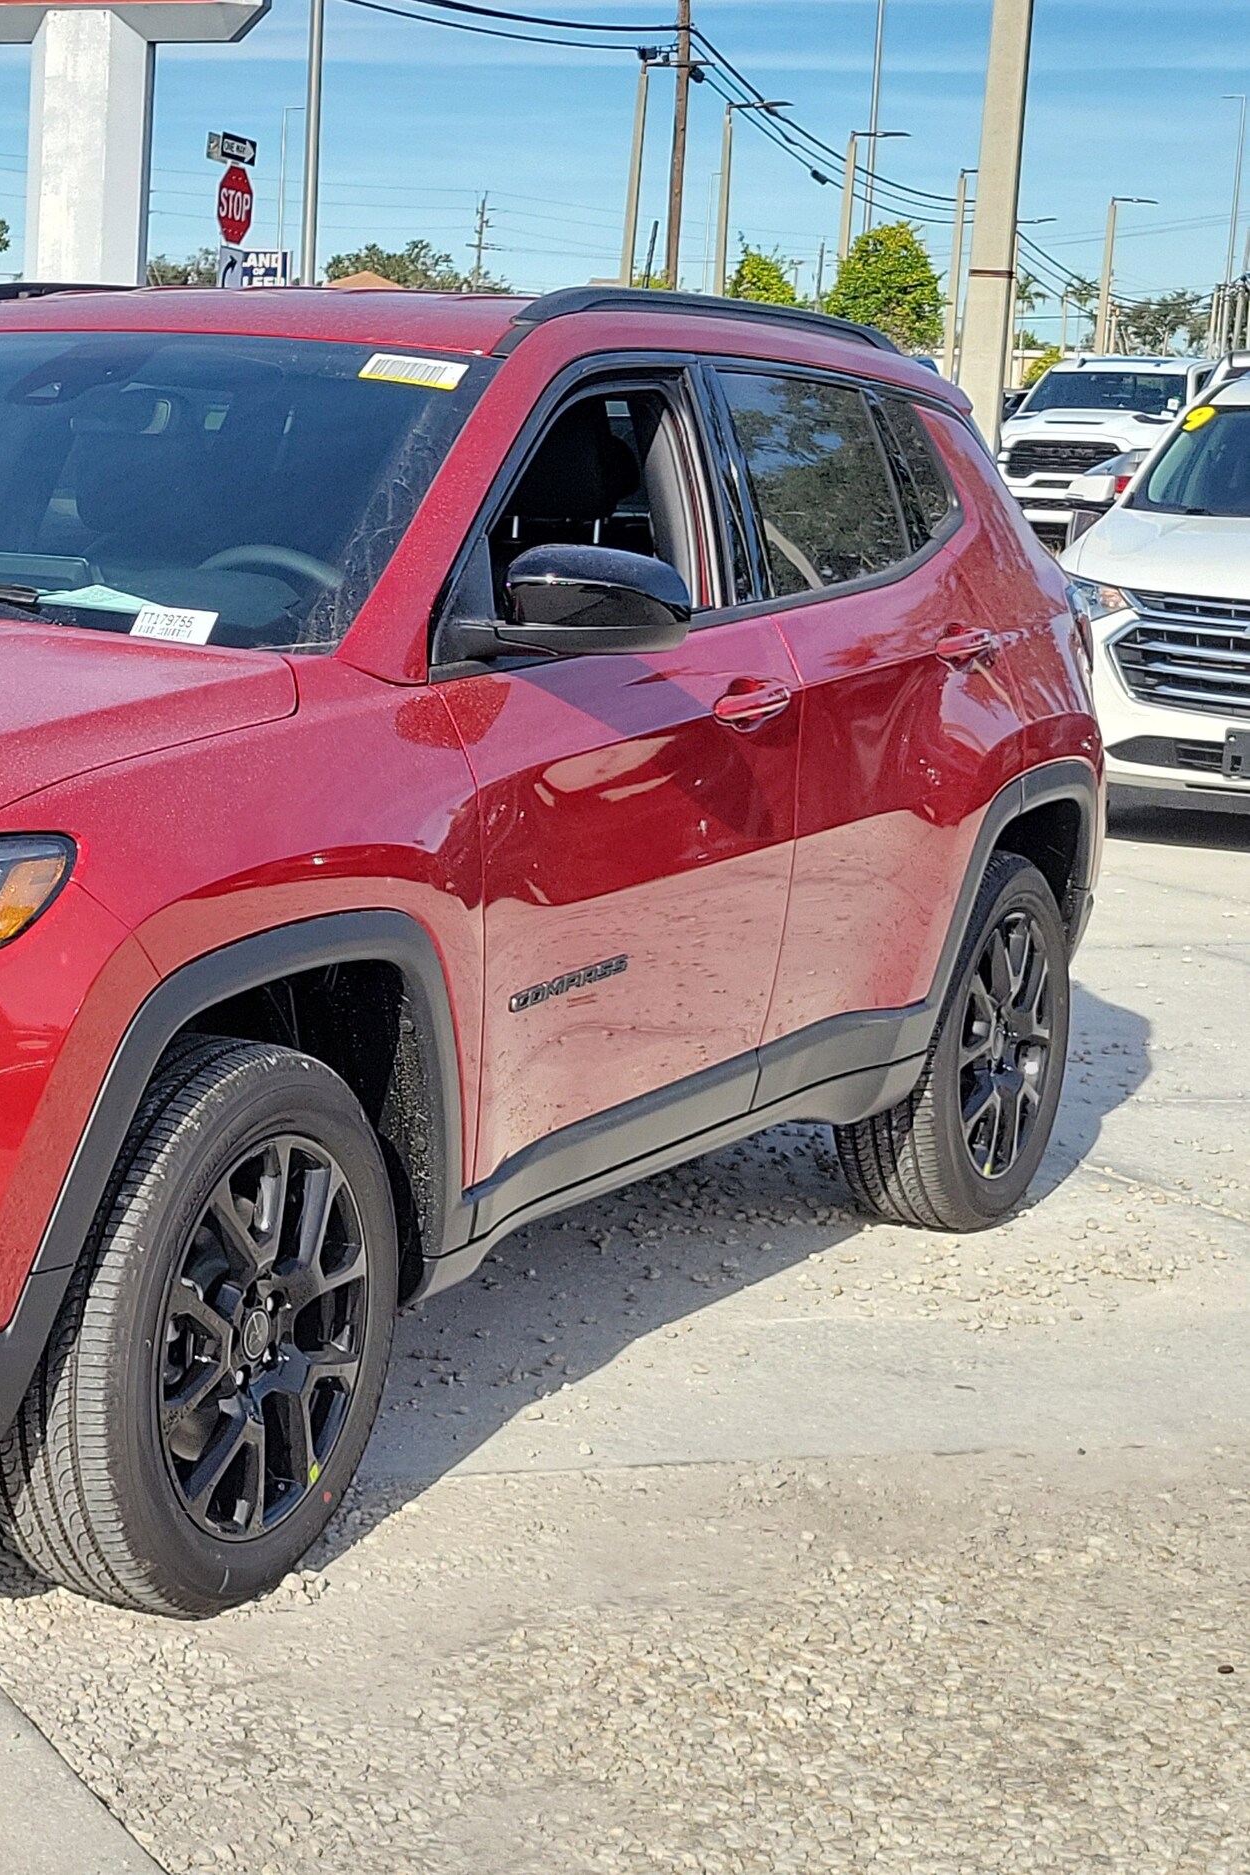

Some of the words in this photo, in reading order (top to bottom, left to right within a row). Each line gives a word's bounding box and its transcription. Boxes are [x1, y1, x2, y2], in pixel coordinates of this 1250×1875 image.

[224, 140, 235, 153] ONE
[219, 187, 251, 222] STOP
[252, 267, 266, 276] OF
[1182, 406, 1216, 431] 9
[140, 611, 196, 629] TT179755
[508, 953, 629, 1013] COMPASS
